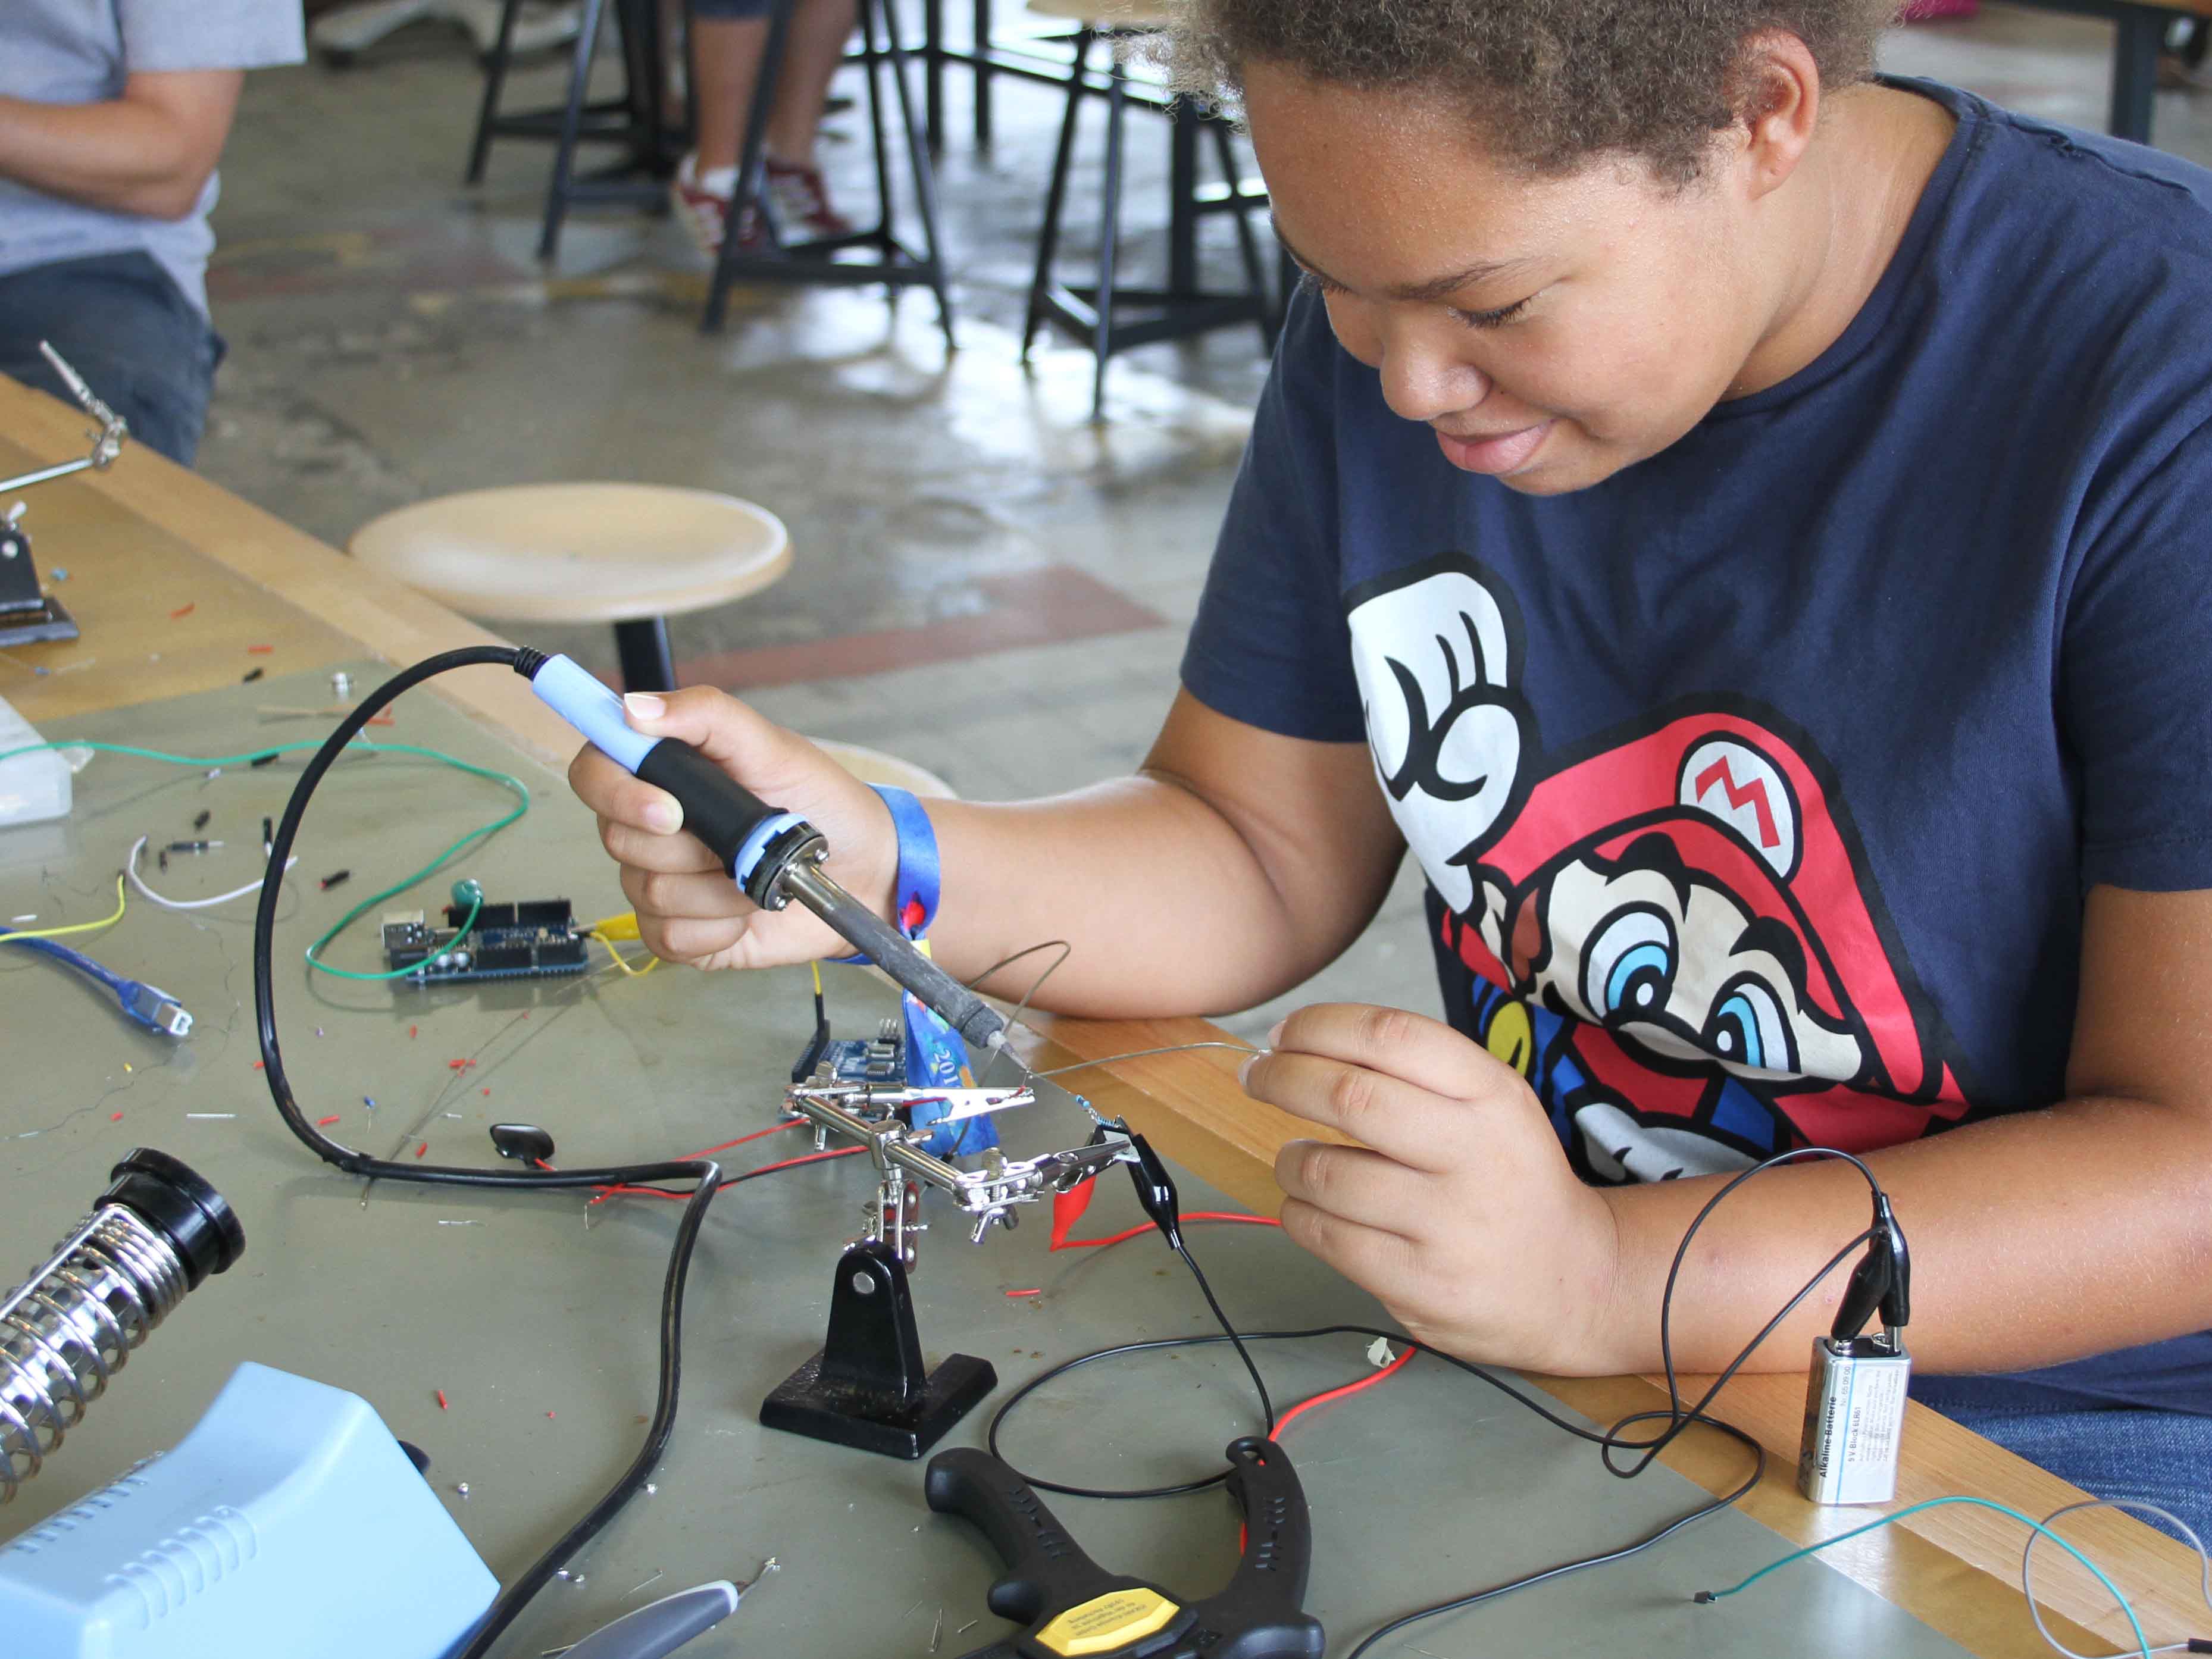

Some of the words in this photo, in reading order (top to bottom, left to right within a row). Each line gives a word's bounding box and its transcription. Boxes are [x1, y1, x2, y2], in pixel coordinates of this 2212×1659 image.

[1695, 755, 1781, 849] M
[933, 1048, 962, 1088] 201
[1819, 1396, 1837, 1478] Alkaline-Batterie
[1852, 1406, 1862, 1427] 6LR61
